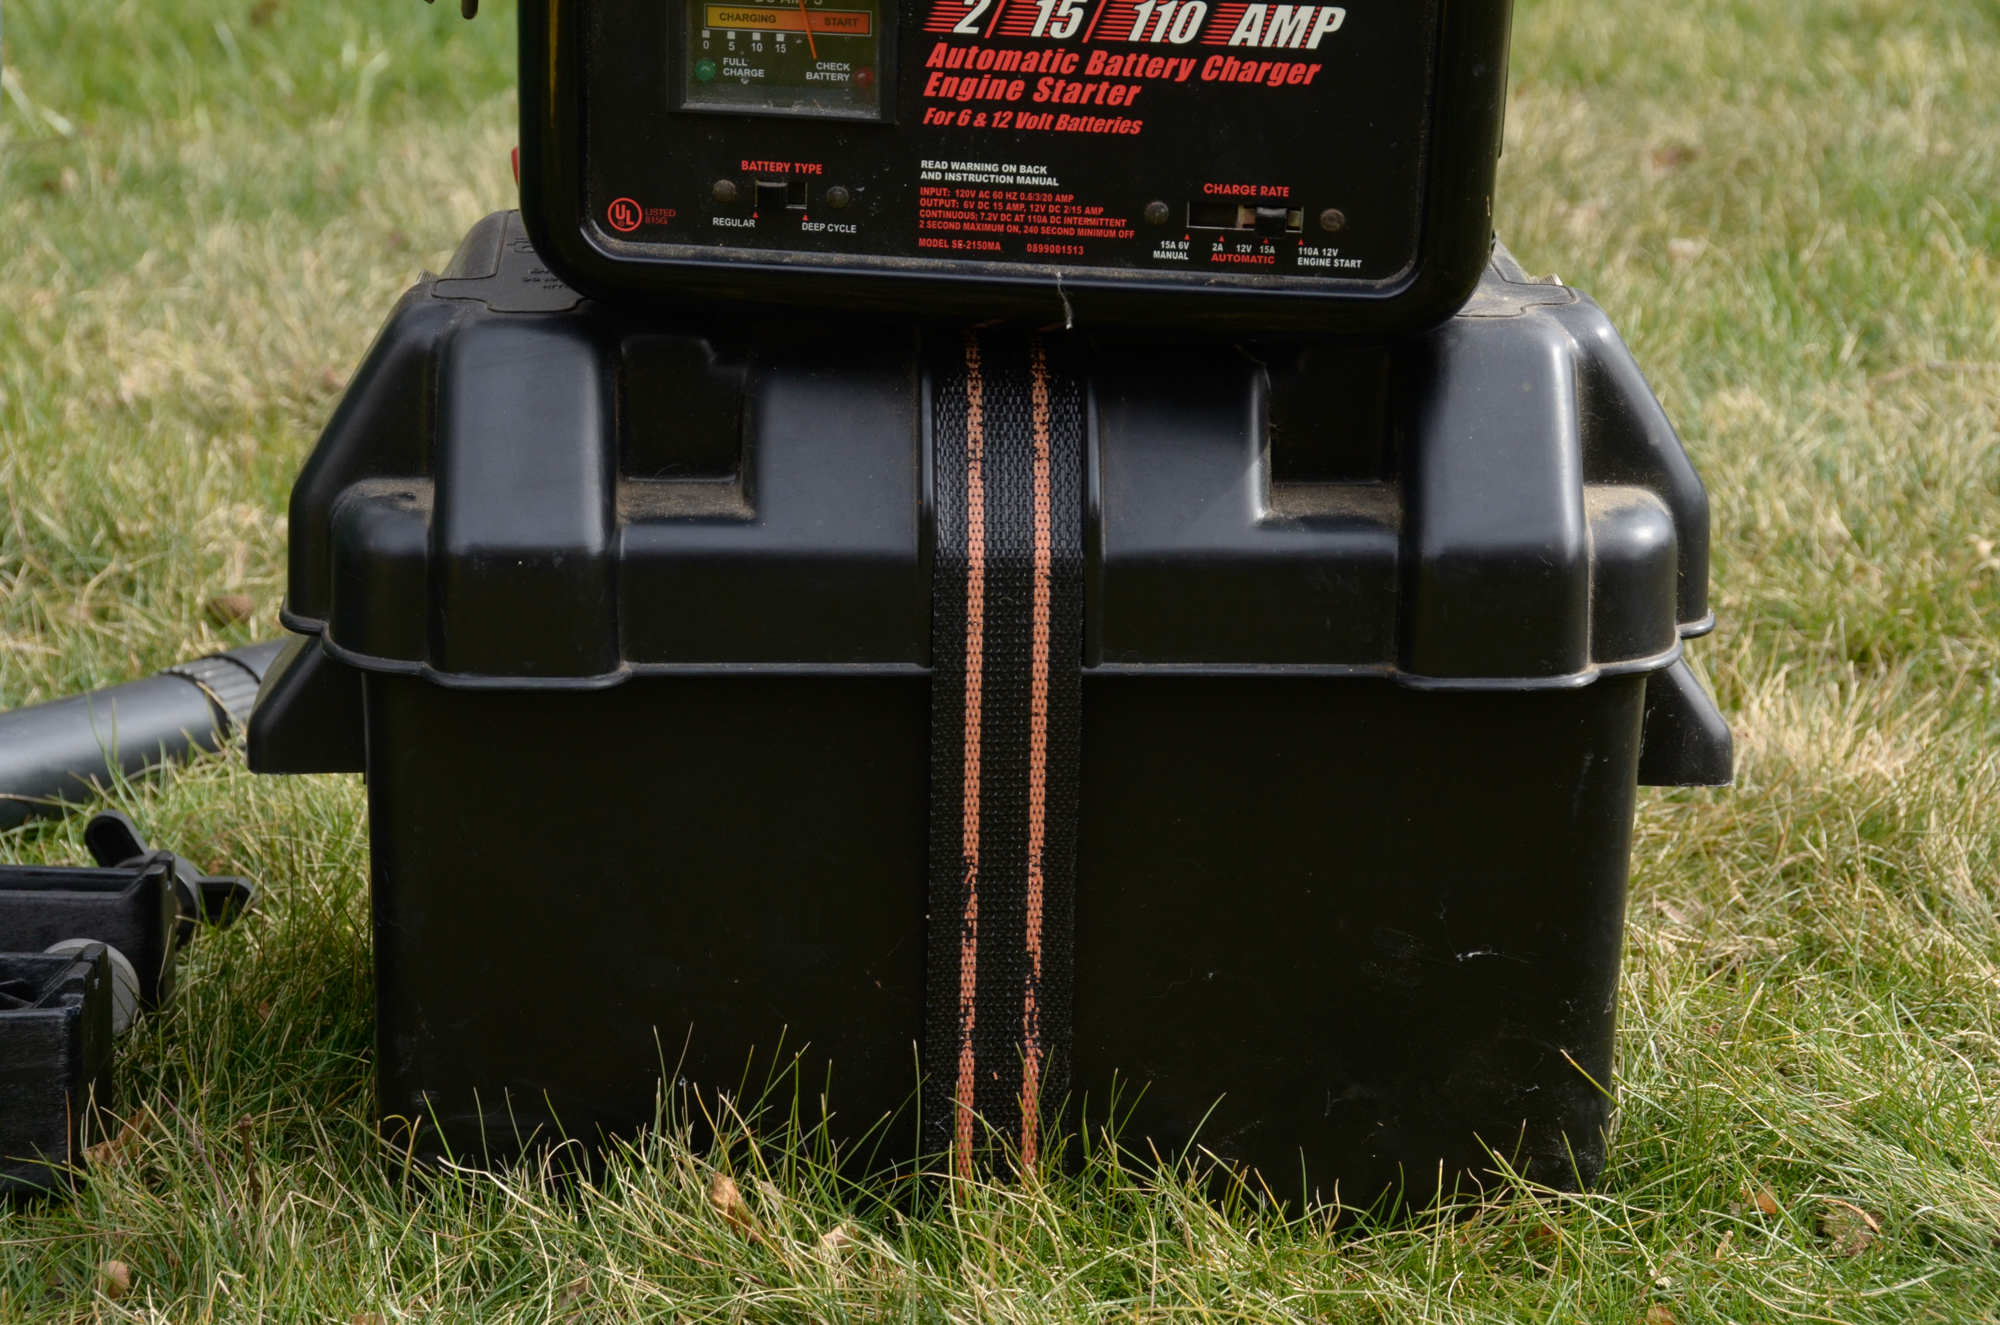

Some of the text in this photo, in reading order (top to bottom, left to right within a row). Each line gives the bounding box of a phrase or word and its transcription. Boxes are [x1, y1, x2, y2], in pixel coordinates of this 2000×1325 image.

[719, 12, 777, 24] CHARGING
[824, 17, 859, 27] START
[1227, 3, 1346, 49] AMP
[703, 40, 710, 50] 0
[728, 42, 735, 51] 5
[751, 43, 763, 52] 10
[775, 44, 787, 53] 15
[723, 57, 748, 67] FULL
[816, 62, 850, 72] CHECK
[925, 42, 1322, 87] Automatic Battery Charger
[723, 67, 765, 78] CHARGE
[806, 72, 850, 82] BATTERY
[923, 71, 1142, 106] Engine Starter
[922, 107, 1143, 136] For 6 & 12 Volt Batteries
[741, 160, 823, 175] BATTERY TYPE
[921, 160, 1048, 175] READ WARNING ON BACK
[920, 171, 1060, 187] AND INSTRUCTION MANUAL
[920, 187, 951, 197] INPUT:
[955, 189, 977, 198] 120V
[978, 190, 991, 199] AC
[992, 191, 1004, 200] 60
[1005, 192, 1018, 201] HZ
[1055, 194, 1074, 203] AMP
[1203, 183, 1290, 197] CHARGE RATE
[645, 208, 677, 217] LISTED
[919, 198, 1104, 216] OUTPUT: 6V DC 15 AMP, 12V DC 2/15 AMP
[615, 204, 635, 226] UL
[645, 216, 668, 225] 815G
[980, 212, 999, 221] 7.2V
[1000, 213, 1012, 222] DC
[1014, 214, 1025, 223] AT
[1027, 214, 1048, 224] 110A
[1050, 215, 1062, 224] DC
[1063, 216, 1126, 228] INTERMITTENT
[712, 217, 756, 228] REGULAR
[802, 222, 857, 234] DEEP CYCLE
[919, 220, 1135, 239] 2 SECOND MAXIMUM ON, 240 SECOND MINIMUM OFF
[918, 238, 1001, 251] MODEL SE-2150MA
[1026, 243, 1084, 255] 0899001513
[1160, 240, 1190, 250] 15A 6V
[1212, 243, 1224, 252] 2A
[1236, 244, 1252, 253] 12V
[1260, 245, 1275, 254] 15A
[1153, 250, 1189, 260] MANUAL
[1298, 247, 1338, 257] 110A 12V
[1211, 253, 1275, 264] AUTOMATIC
[1297, 257, 1362, 268] ENGINE START
